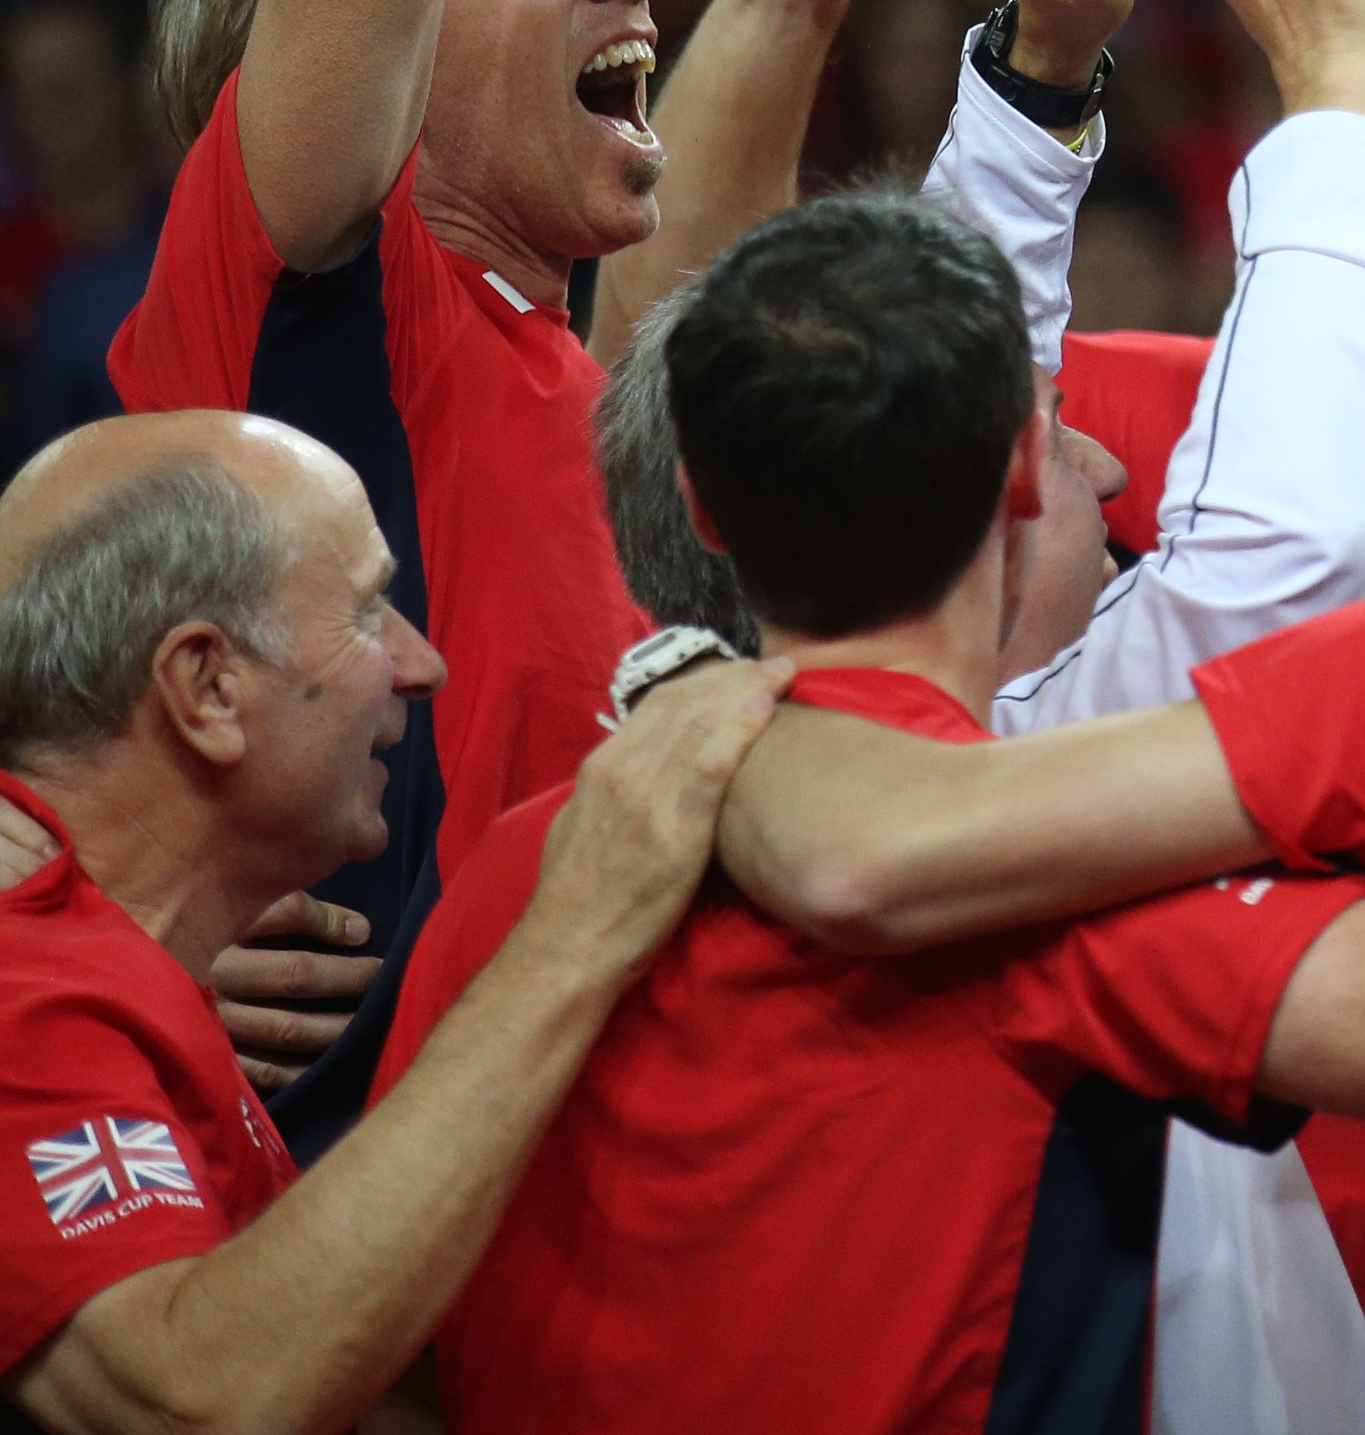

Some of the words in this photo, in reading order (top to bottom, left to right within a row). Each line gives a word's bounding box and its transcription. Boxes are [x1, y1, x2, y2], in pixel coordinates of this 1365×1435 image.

[60, 1210, 116, 1240] DAVIS
[117, 1194, 153, 1218] CUP
[153, 1192, 204, 1209] TEAM
